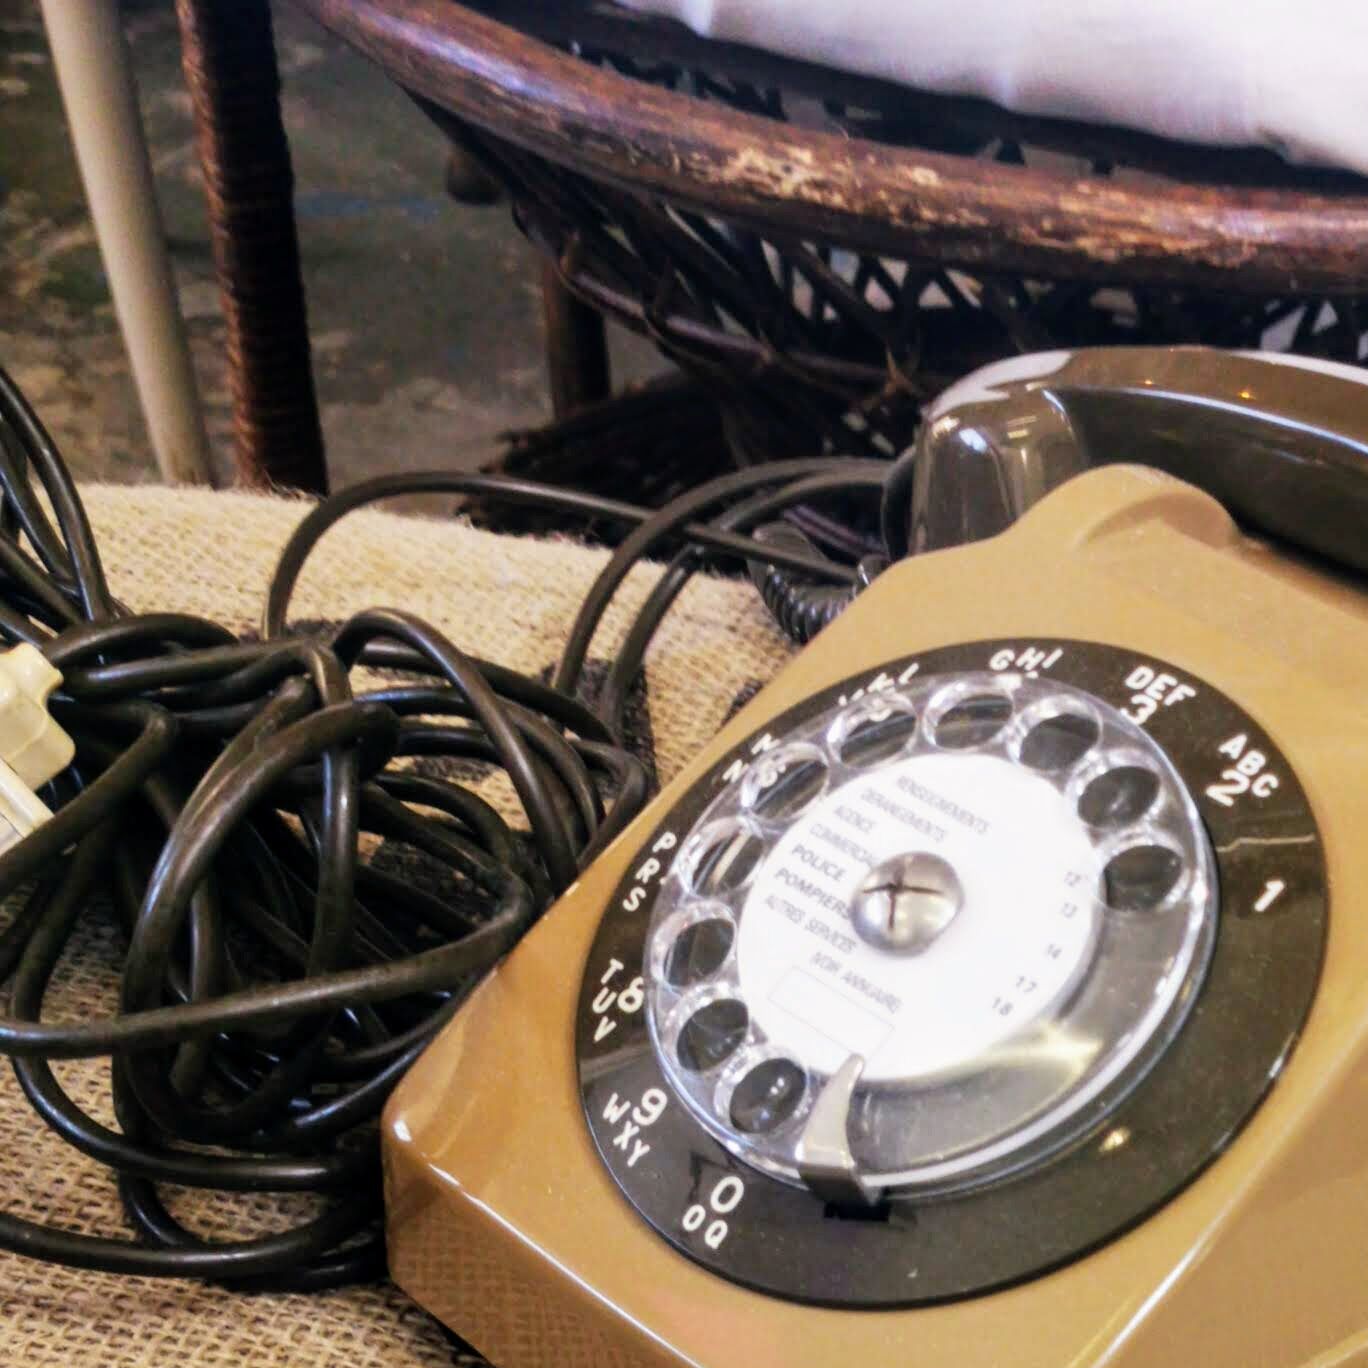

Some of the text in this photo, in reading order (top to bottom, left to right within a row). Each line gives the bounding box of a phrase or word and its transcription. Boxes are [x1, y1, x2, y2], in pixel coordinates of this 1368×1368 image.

[988, 646, 1064, 671] GHI
[1124, 665, 1197, 706] DEF
[1119, 694, 1159, 726] 3
[1217, 733, 1281, 799] ABC
[1205, 769, 1251, 807] 2
[1253, 877, 1286, 913] 1
[790, 843, 1038, 994] POLICE 17
[773, 866, 1014, 1016] POMPIERS 18
[592, 957, 625, 1043] TUV
[631, 1086, 669, 1127] 9
[602, 1091, 651, 1169] WXY
[709, 1175, 745, 1215] 0
